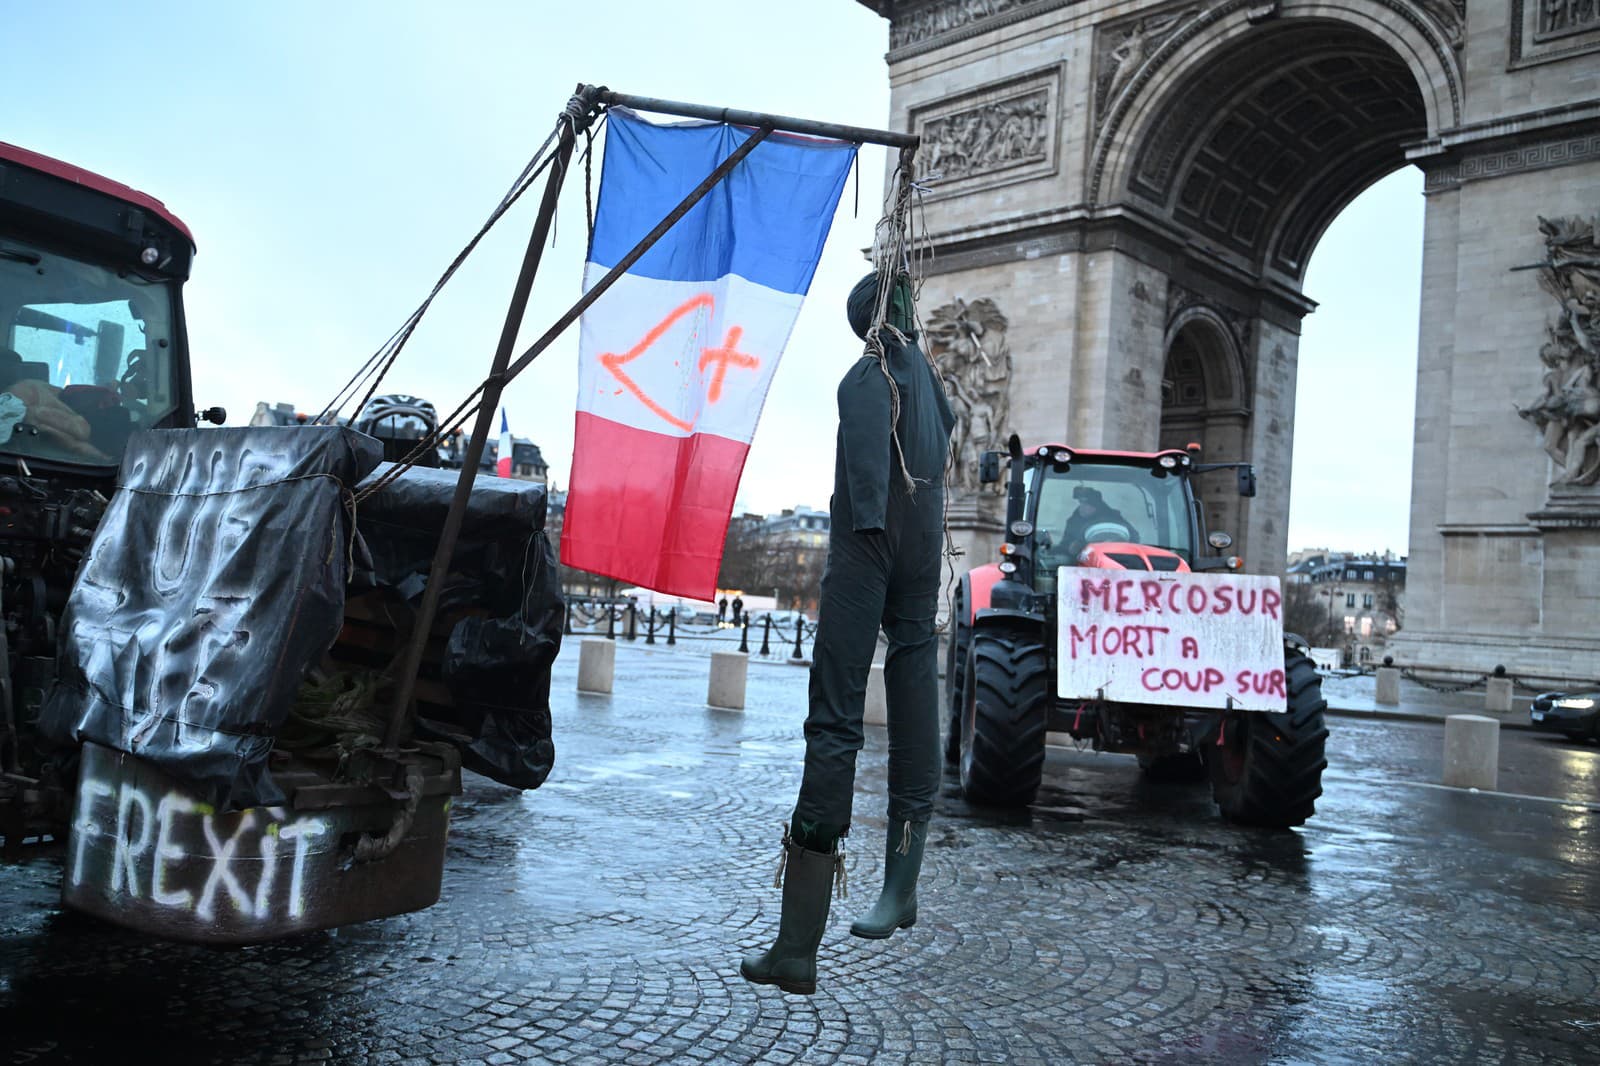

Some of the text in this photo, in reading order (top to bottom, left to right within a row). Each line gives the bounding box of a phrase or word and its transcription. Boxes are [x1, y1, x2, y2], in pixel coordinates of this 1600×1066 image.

[1080, 578, 1282, 620] MERCOSUR
[1070, 623, 1199, 660] MORT A
[1141, 667, 1287, 699] COUP SUR
[72, 779, 331, 922] FREXIT
